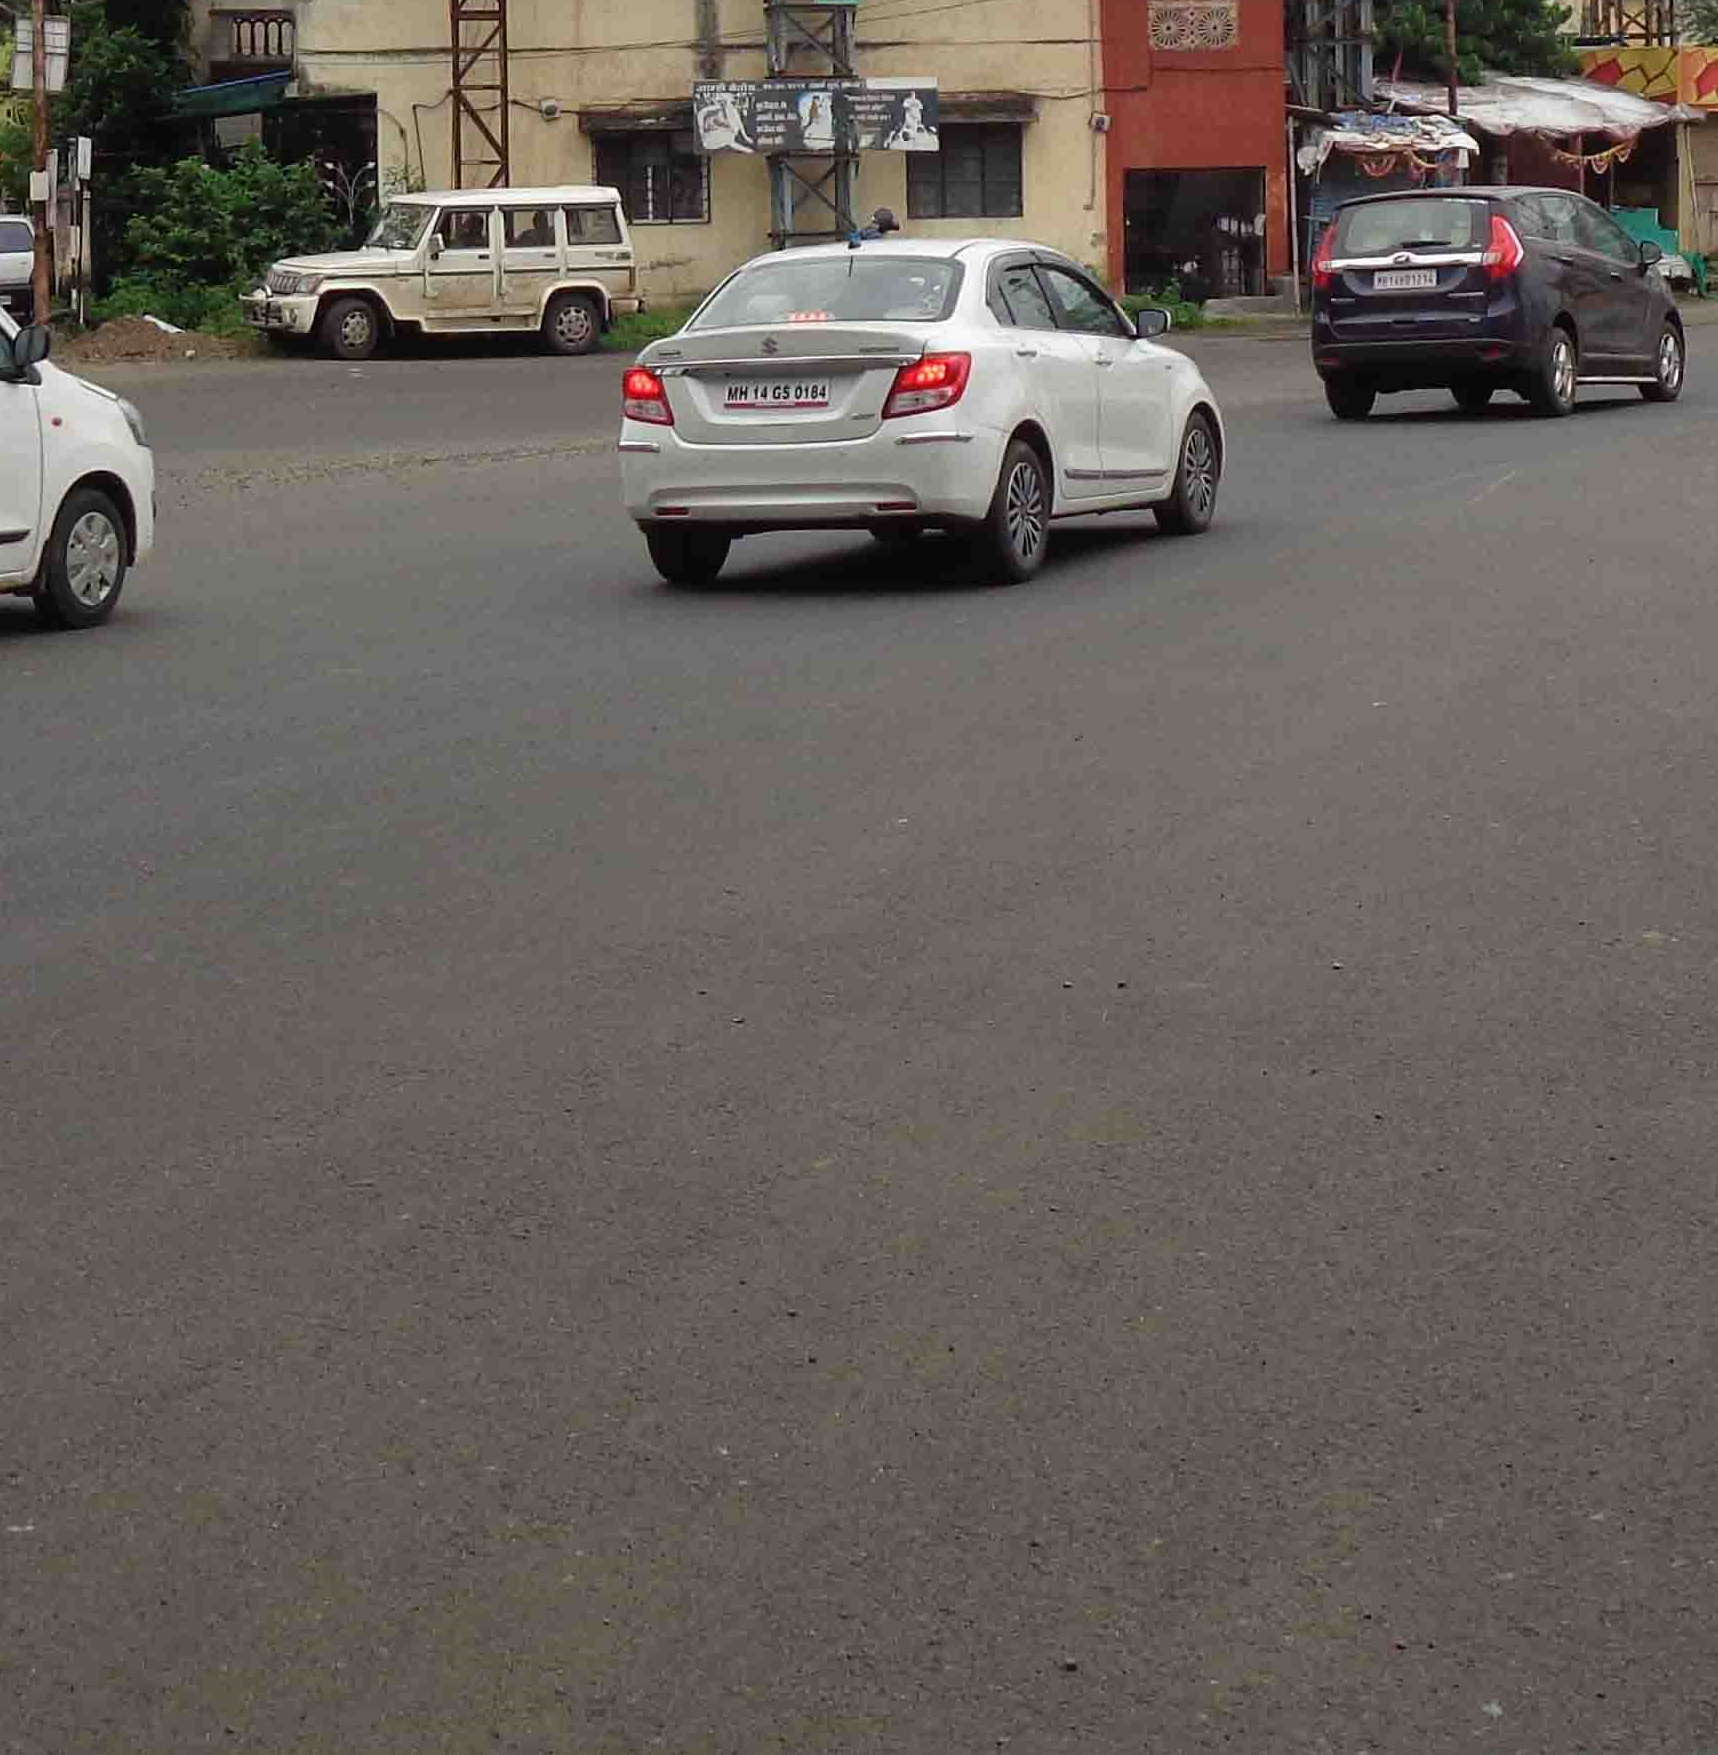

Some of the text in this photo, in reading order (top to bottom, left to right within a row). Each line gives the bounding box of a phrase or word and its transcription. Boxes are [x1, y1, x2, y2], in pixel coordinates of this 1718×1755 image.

[726, 384, 747, 401] MH
[753, 384, 767, 400] 14
[795, 383, 827, 399] 0184
